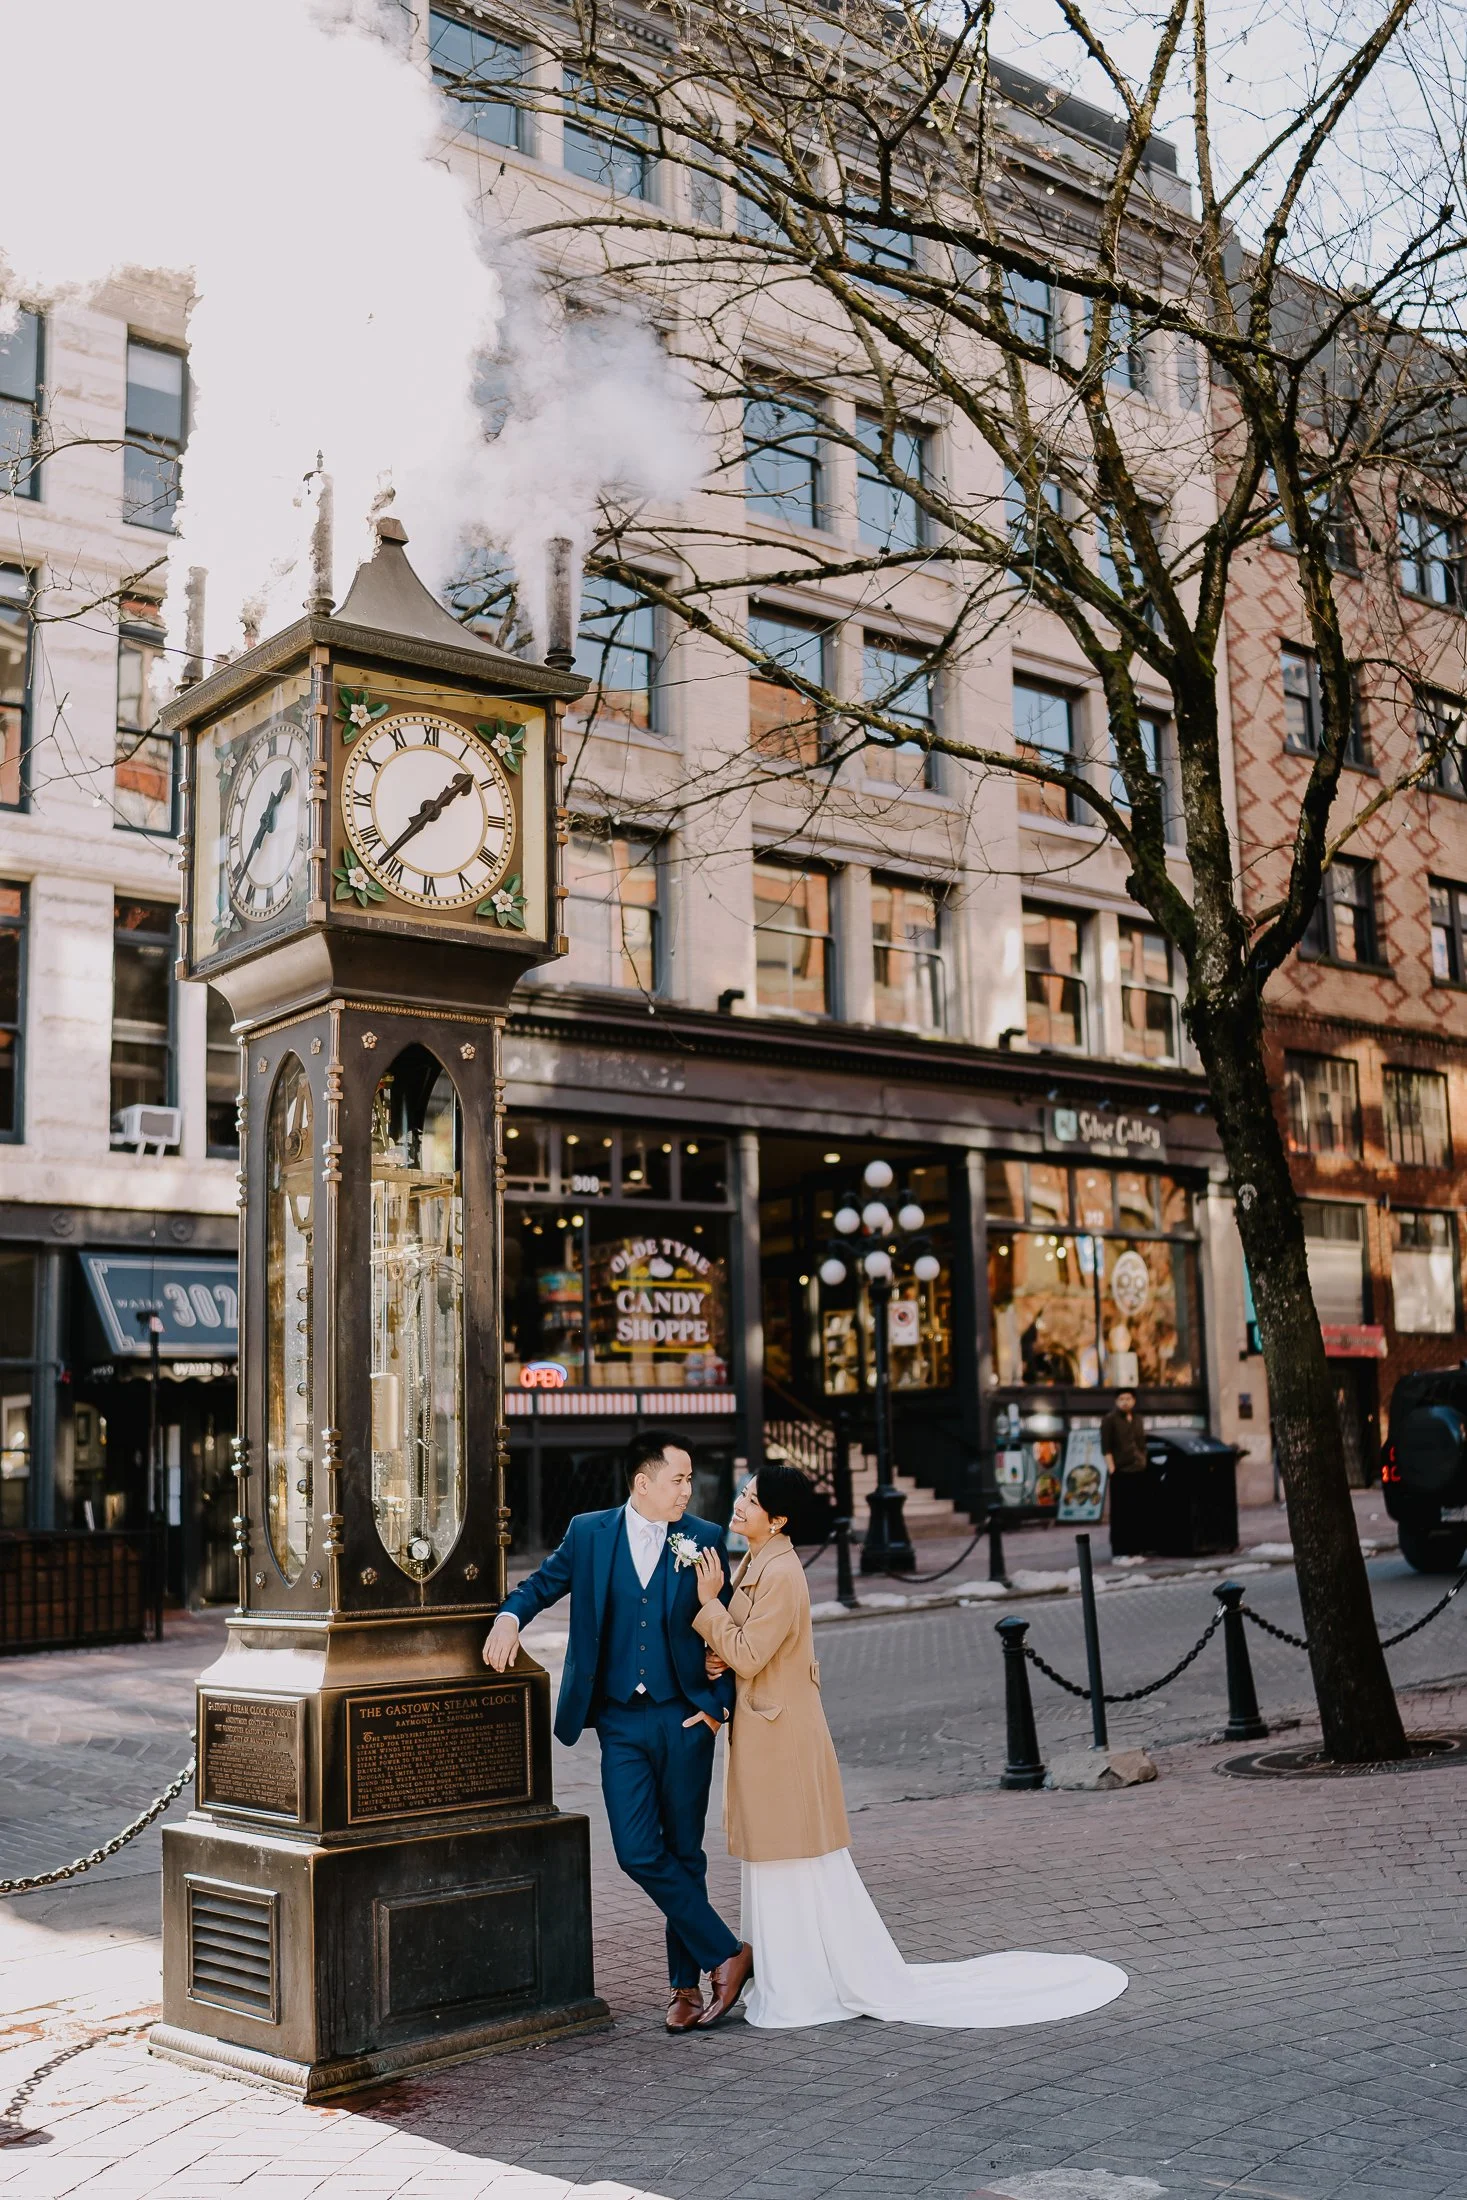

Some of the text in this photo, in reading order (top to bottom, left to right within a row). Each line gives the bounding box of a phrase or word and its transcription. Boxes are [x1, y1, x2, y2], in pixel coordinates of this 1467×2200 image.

[610, 1238, 712, 1276] OLDE TYME
[163, 1282, 239, 1329] 302
[616, 1289, 705, 1315] CANDY
[617, 1318, 710, 1343] SHOPPE
[520, 1366, 565, 1389] OPEN
[360, 1708, 382, 1718] THE
[386, 1702, 440, 1716] GASTOWN
[444, 1698, 478, 1710] STEAM
[481, 1694, 518, 1706] CLOCK
[396, 1718, 433, 1727] RAYMOND
[446, 1713, 484, 1722] SAUNDERS
